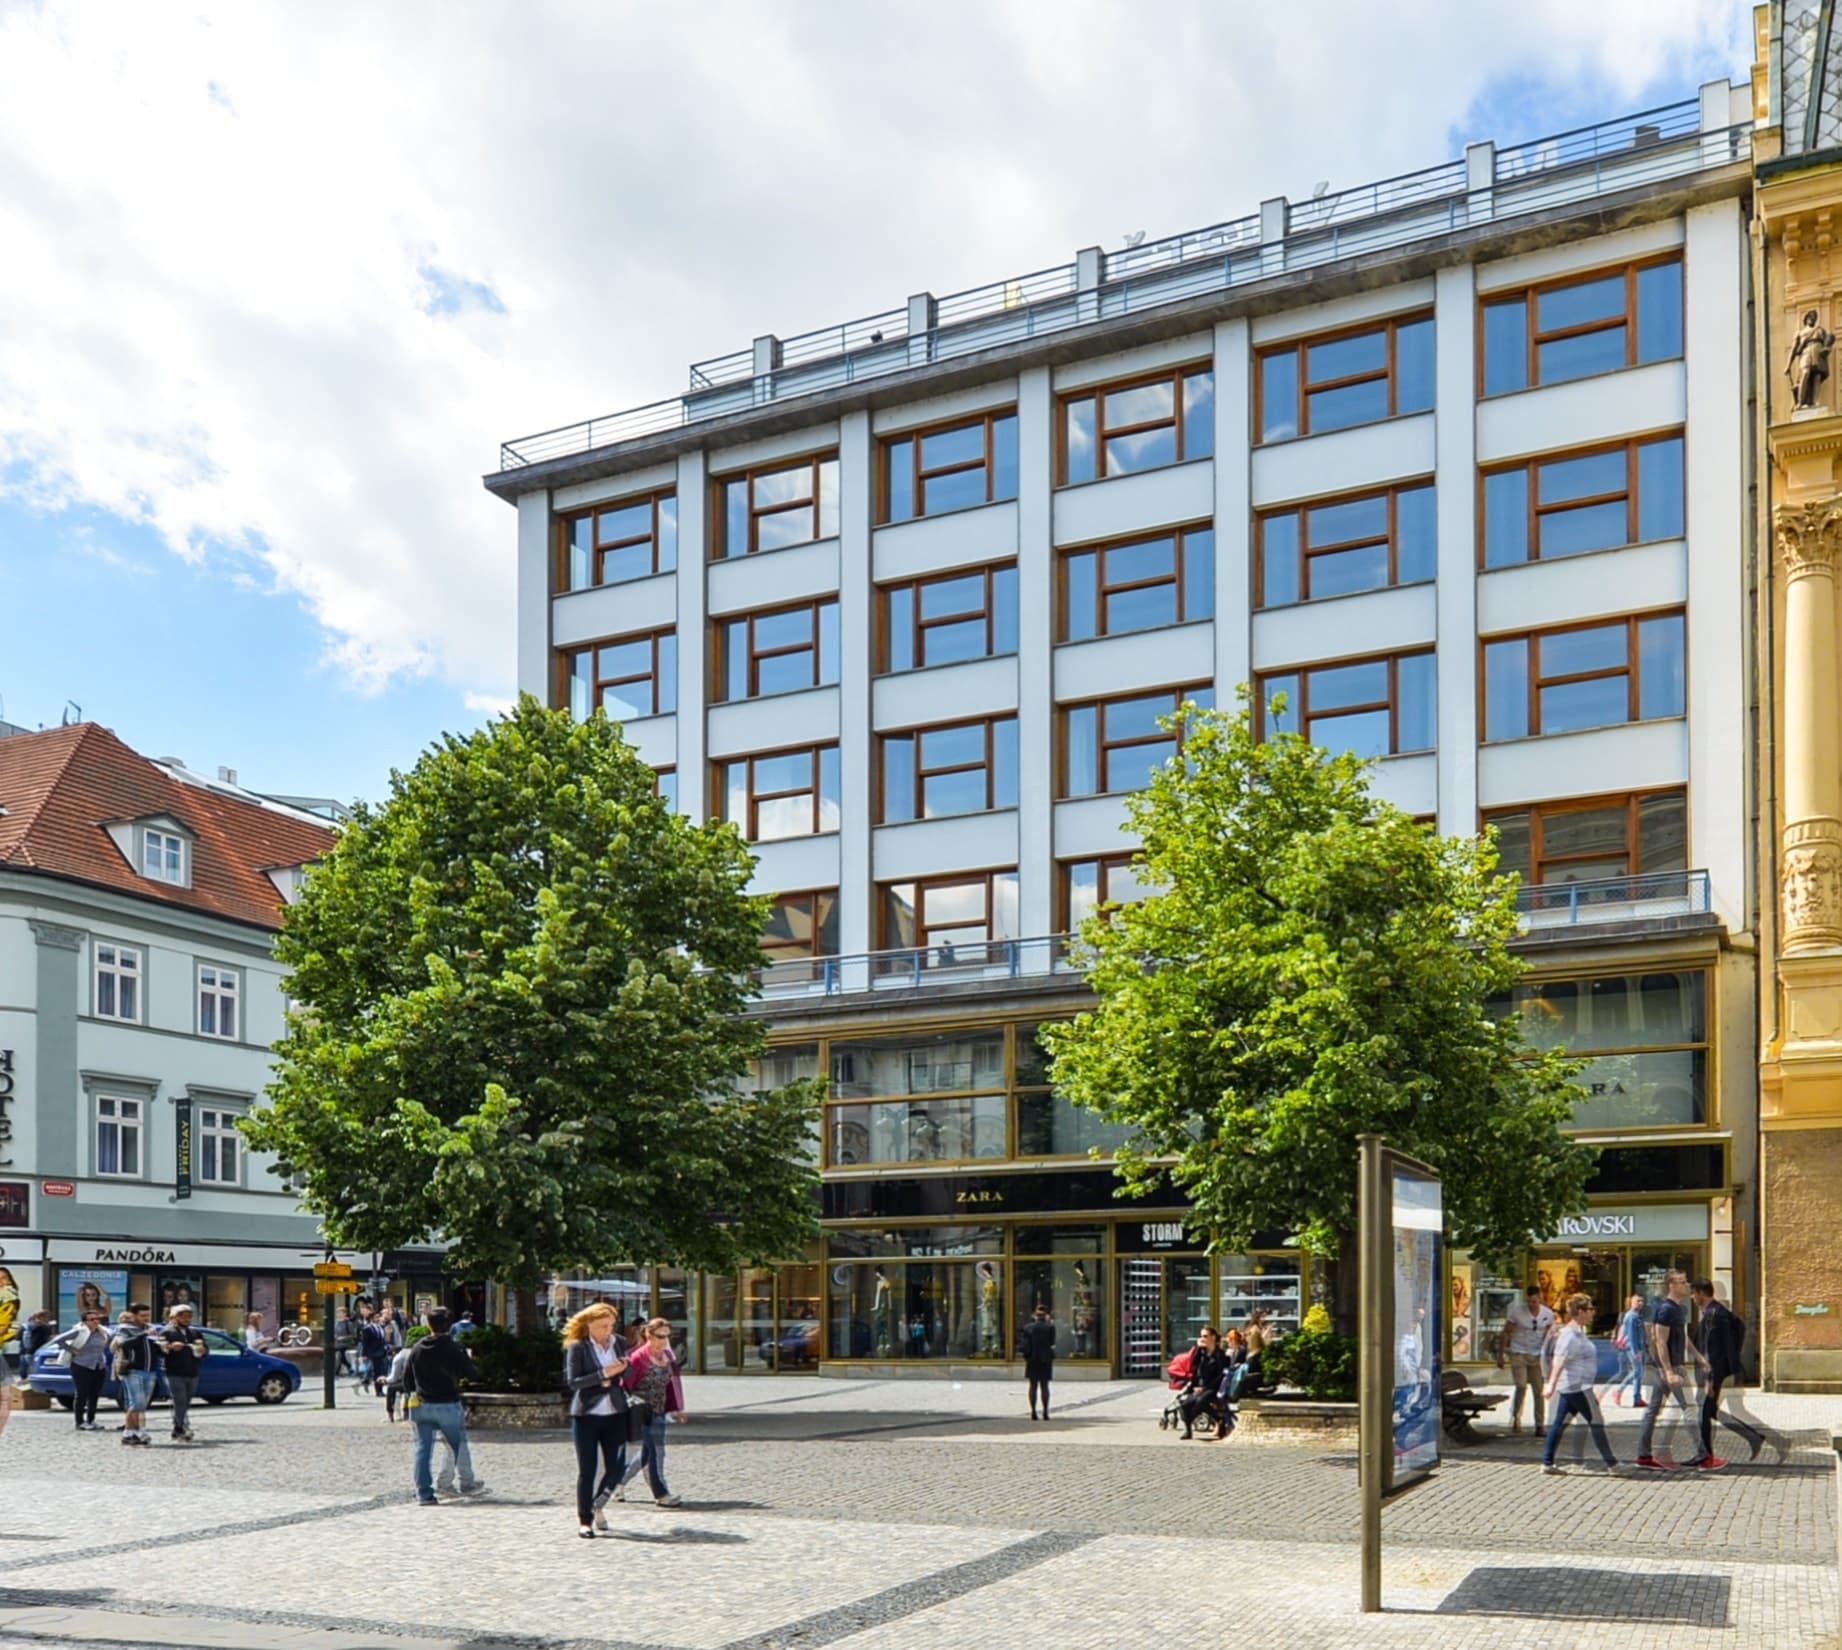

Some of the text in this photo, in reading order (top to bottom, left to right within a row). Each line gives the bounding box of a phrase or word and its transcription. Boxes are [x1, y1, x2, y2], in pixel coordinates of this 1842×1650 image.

[1591, 1083, 1625, 1096] RA
[181, 1120, 189, 1175] FRIDAY
[956, 1191, 1004, 1202] ZARA
[1142, 1222, 1184, 1242] STORM
[1556, 1215, 1635, 1235] ROVSKI
